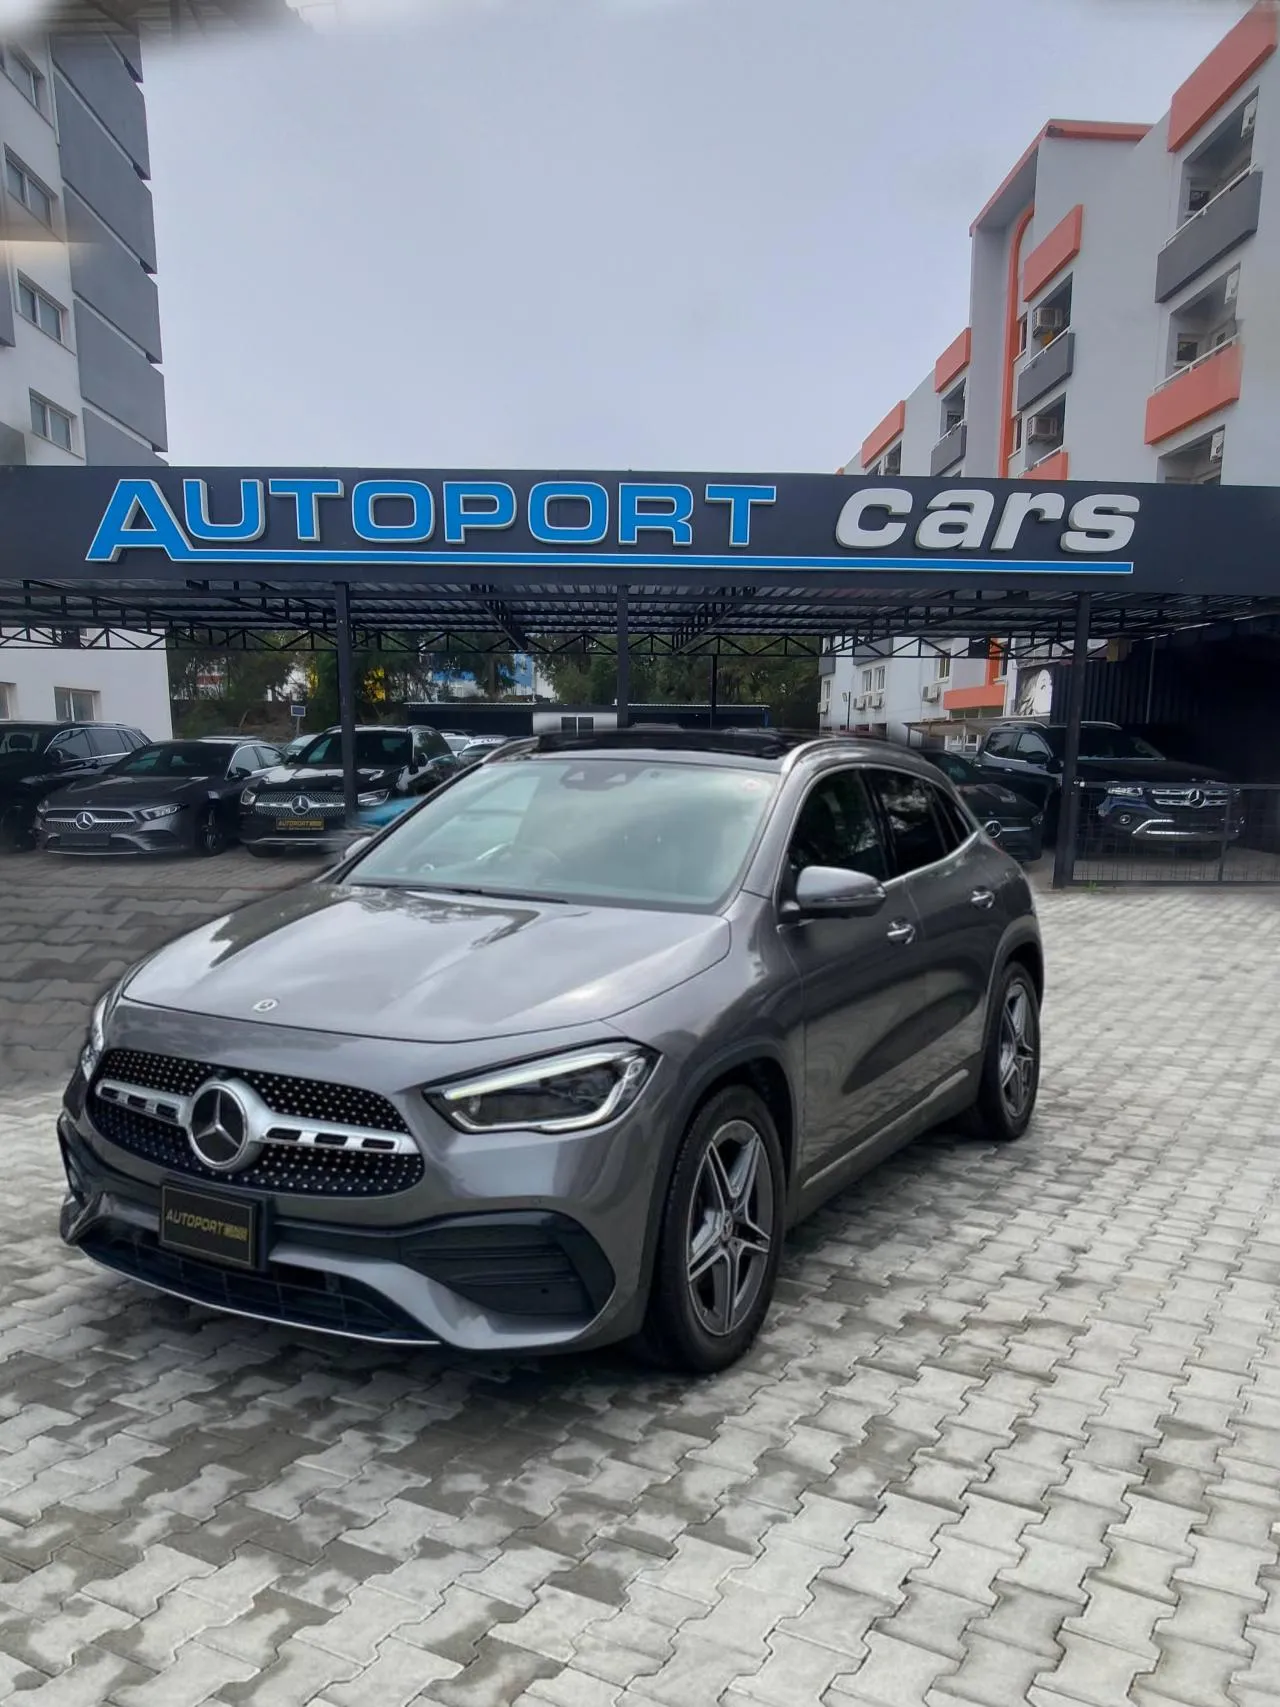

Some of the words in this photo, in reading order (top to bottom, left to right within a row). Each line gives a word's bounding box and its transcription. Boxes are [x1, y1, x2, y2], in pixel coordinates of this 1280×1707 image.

[85, 478, 779, 563] AUTOPORT
[835, 487, 1141, 554] cars
[165, 1208, 224, 1235] AUTOPORT
